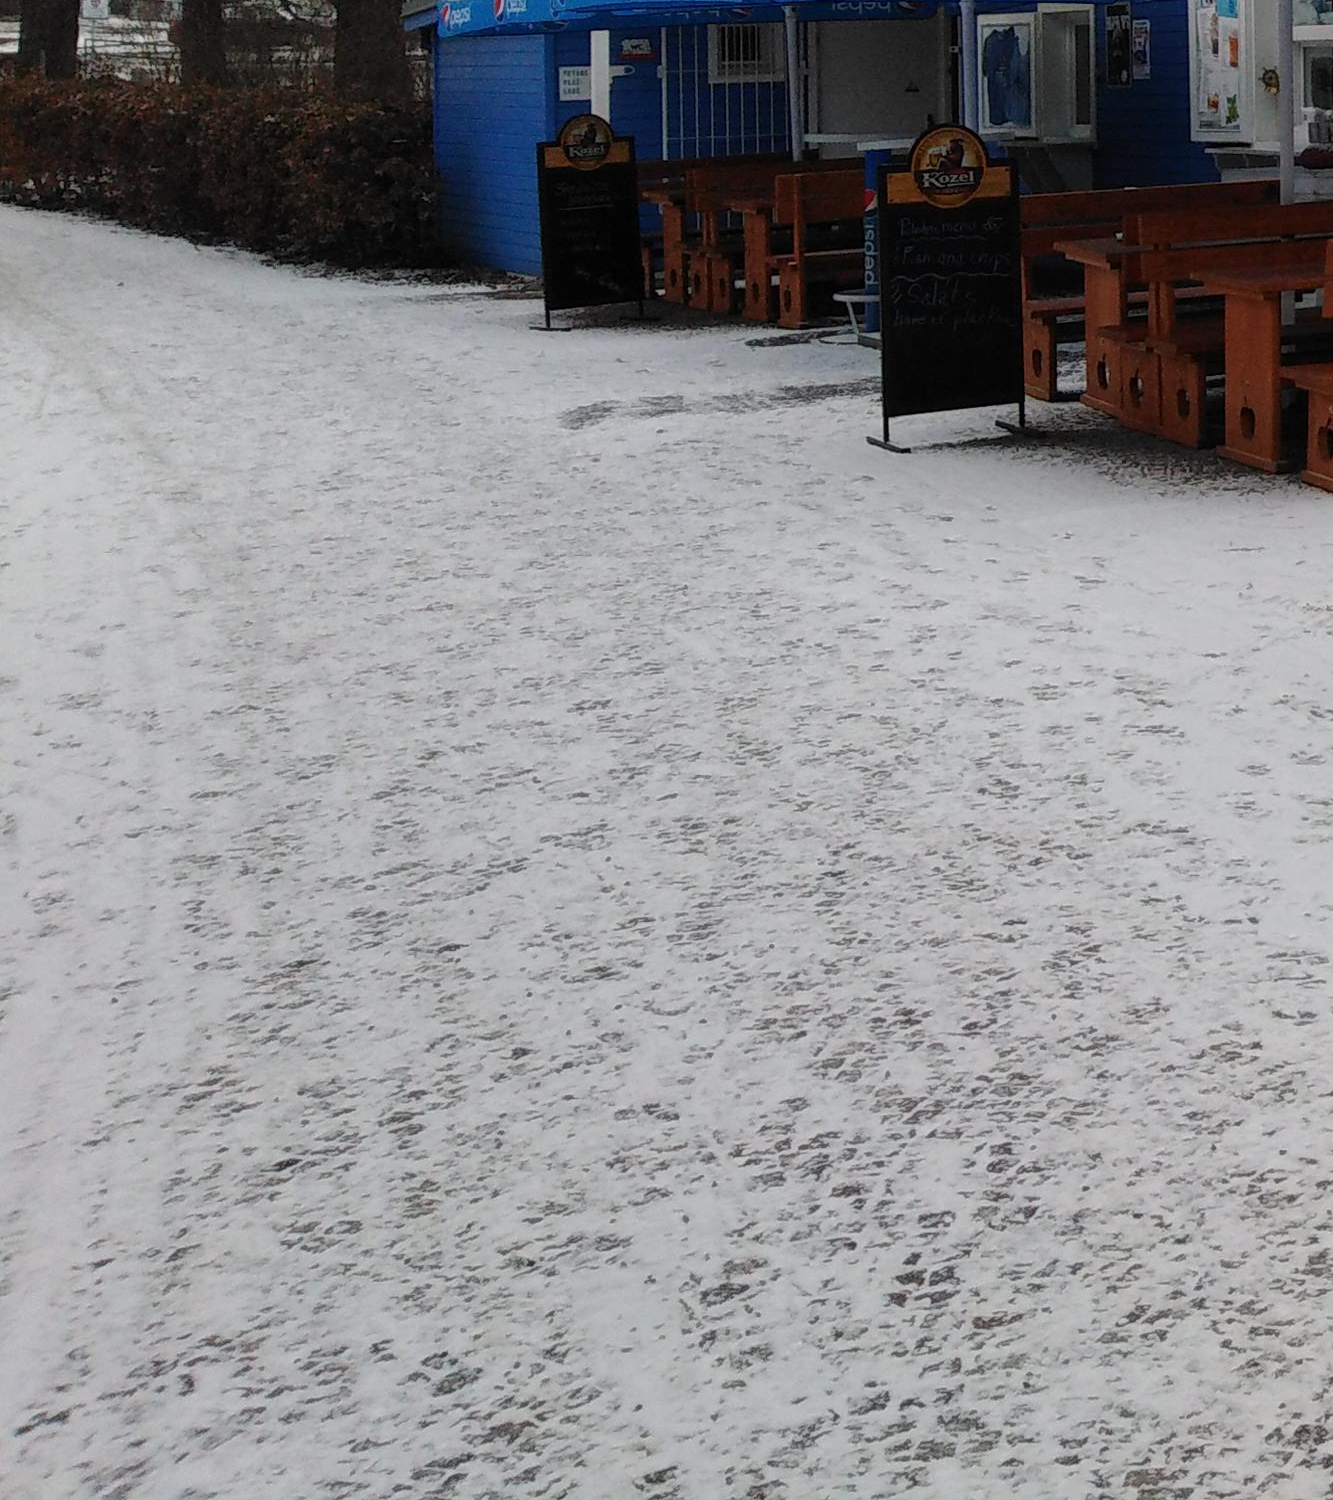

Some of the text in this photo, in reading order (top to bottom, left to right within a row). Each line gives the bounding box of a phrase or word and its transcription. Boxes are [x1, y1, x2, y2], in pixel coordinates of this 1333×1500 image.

[450, 3, 471, 28] pepsi
[568, 144, 606, 158] Kozel
[922, 171, 975, 188] Kozel
[864, 223, 880, 285] pepsi
